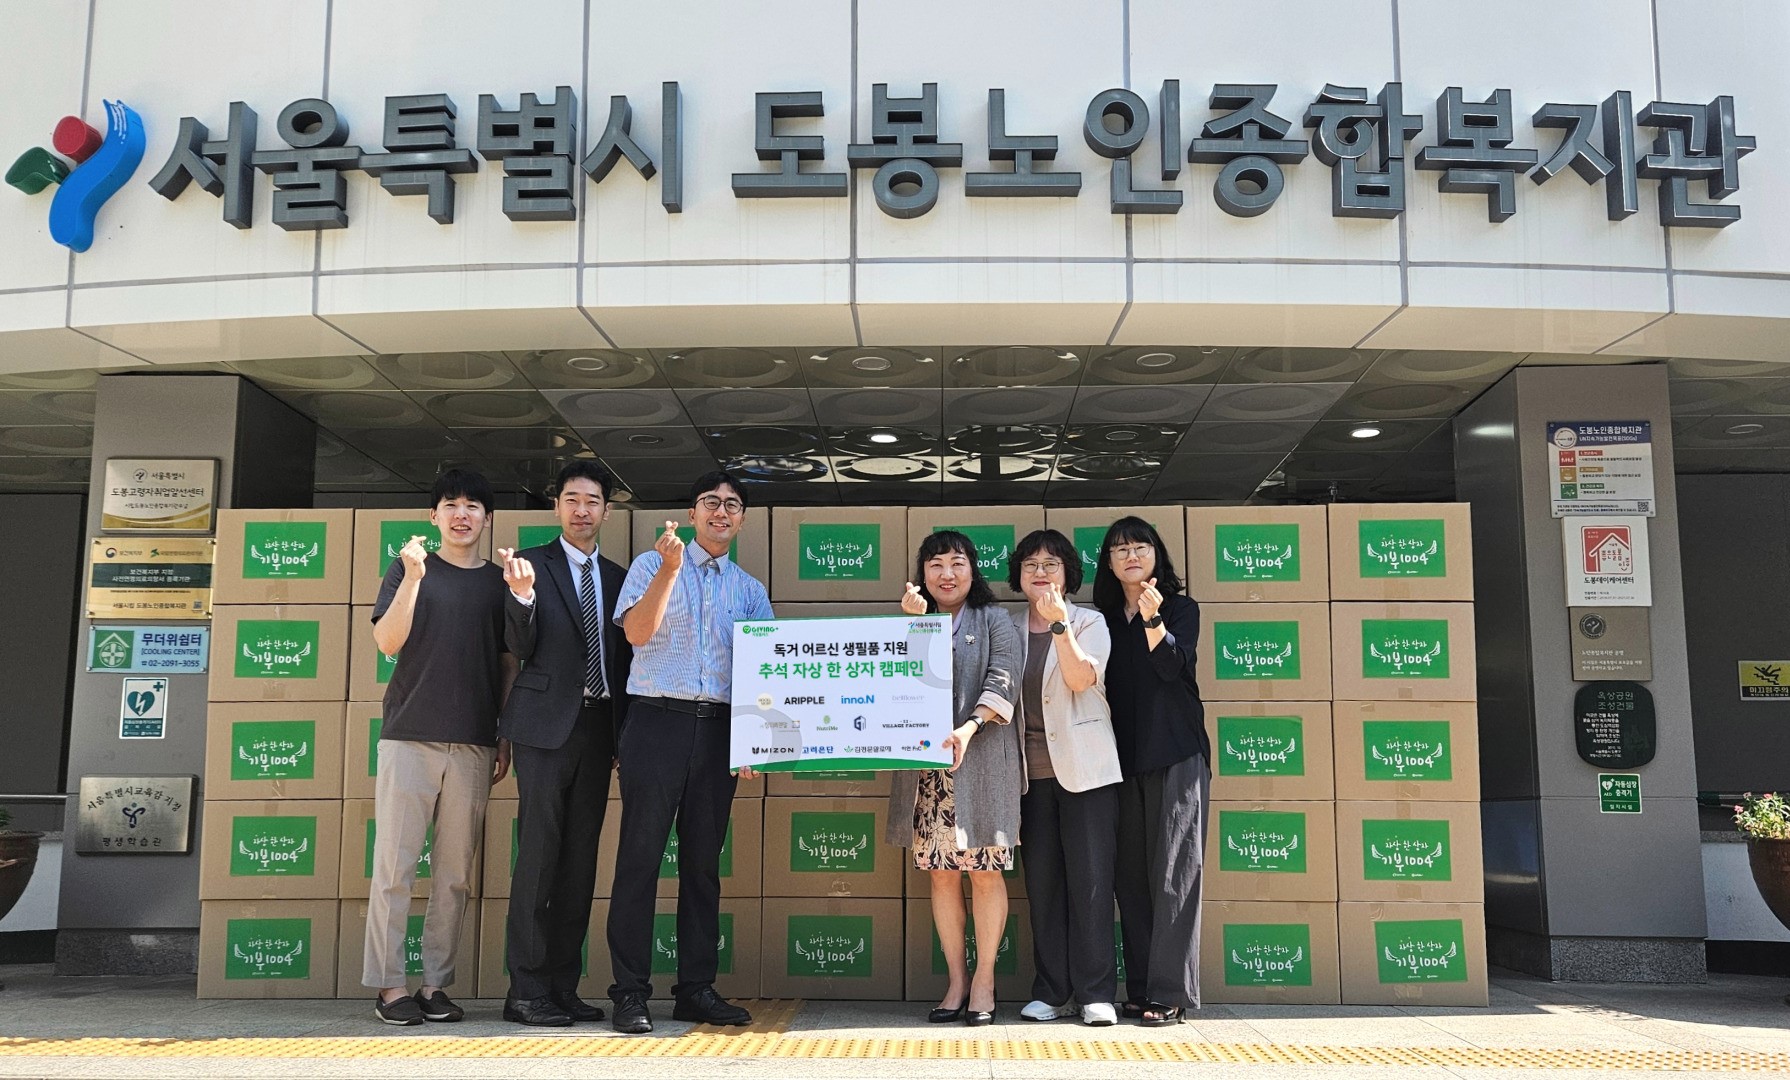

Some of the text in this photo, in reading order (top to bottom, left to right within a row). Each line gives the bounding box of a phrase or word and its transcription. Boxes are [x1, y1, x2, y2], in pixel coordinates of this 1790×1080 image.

[148, 80, 1756, 232] 서울특별시 도봉노인종합복지관
[1580, 426, 1642, 434] 도봉노인종합복지관
[151, 472, 185, 480] 서울특별시
[111, 488, 204, 497] 도봉고령자취업알선센터
[265, 541, 308, 551] 자상 한 상자
[820, 543, 860, 552] 자상 한 상자
[981, 544, 995, 553] 상자
[1237, 543, 1279, 553] 자상 한 상자
[1381, 539, 1424, 549] 자상 한 상자
[260, 553, 309, 571] 기부1004
[815, 555, 864, 572] 기부1004
[1233, 556, 1283, 573] 기부1004
[1378, 552, 1429, 569] 기부1004
[142, 633, 201, 646] 무더위쉼터
[257, 640, 298, 650] 자상 한 상자
[1385, 639, 1427, 649] 자상 한 상자
[774, 641, 908, 657] 독거 어르신 생필품 지원
[1237, 641, 1279, 651] 자상 한 상자
[174, 648, 200, 656] CENTER]
[253, 653, 301, 670] 기부1004
[1233, 654, 1284, 671] 기부1004
[1381, 652, 1432, 670] 기부1004
[759, 660, 924, 680] 추석 자상 한 상자 캠페인
[784, 696, 825, 704] ARIPPLE
[1598, 692, 1633, 700] 옥상공원
[253, 741, 294, 751] 자상 한 상자
[1240, 737, 1282, 747] 자상 한 상자
[1386, 741, 1429, 751] 자상 한 상자
[802, 746, 833, 754] 고려은단
[249, 754, 298, 771] 기부1004
[1236, 750, 1287, 767] 기부1004
[1382, 753, 1434, 772] 기부1004
[87, 788, 182, 811] 서울특별시교육감 지정
[102, 837, 162, 847] 평생학습관
[253, 836, 297, 847] 자상 한 상자
[813, 833, 854, 843] 자상 한 상자
[1242, 832, 1284, 842] 자상 한 상자
[1386, 840, 1428, 851] 자상 한 상자
[249, 849, 298, 867] 기부1004
[808, 845, 857, 863] 기부1004
[1238, 845, 1289, 863] 기부1004
[1382, 854, 1433, 872] 기부1004
[248, 939, 290, 949] 자상 한 상자
[810, 936, 851, 947] 자상 한 상자
[1399, 941, 1442, 952] 자상 한 상자
[1246, 945, 1289, 955] 자상 한 상자
[244, 952, 292, 967] 기부1004
[805, 949, 855, 968] 기부1004
[1396, 954, 1448, 973] 기부1004
[1243, 958, 1294, 977] 기부1004
